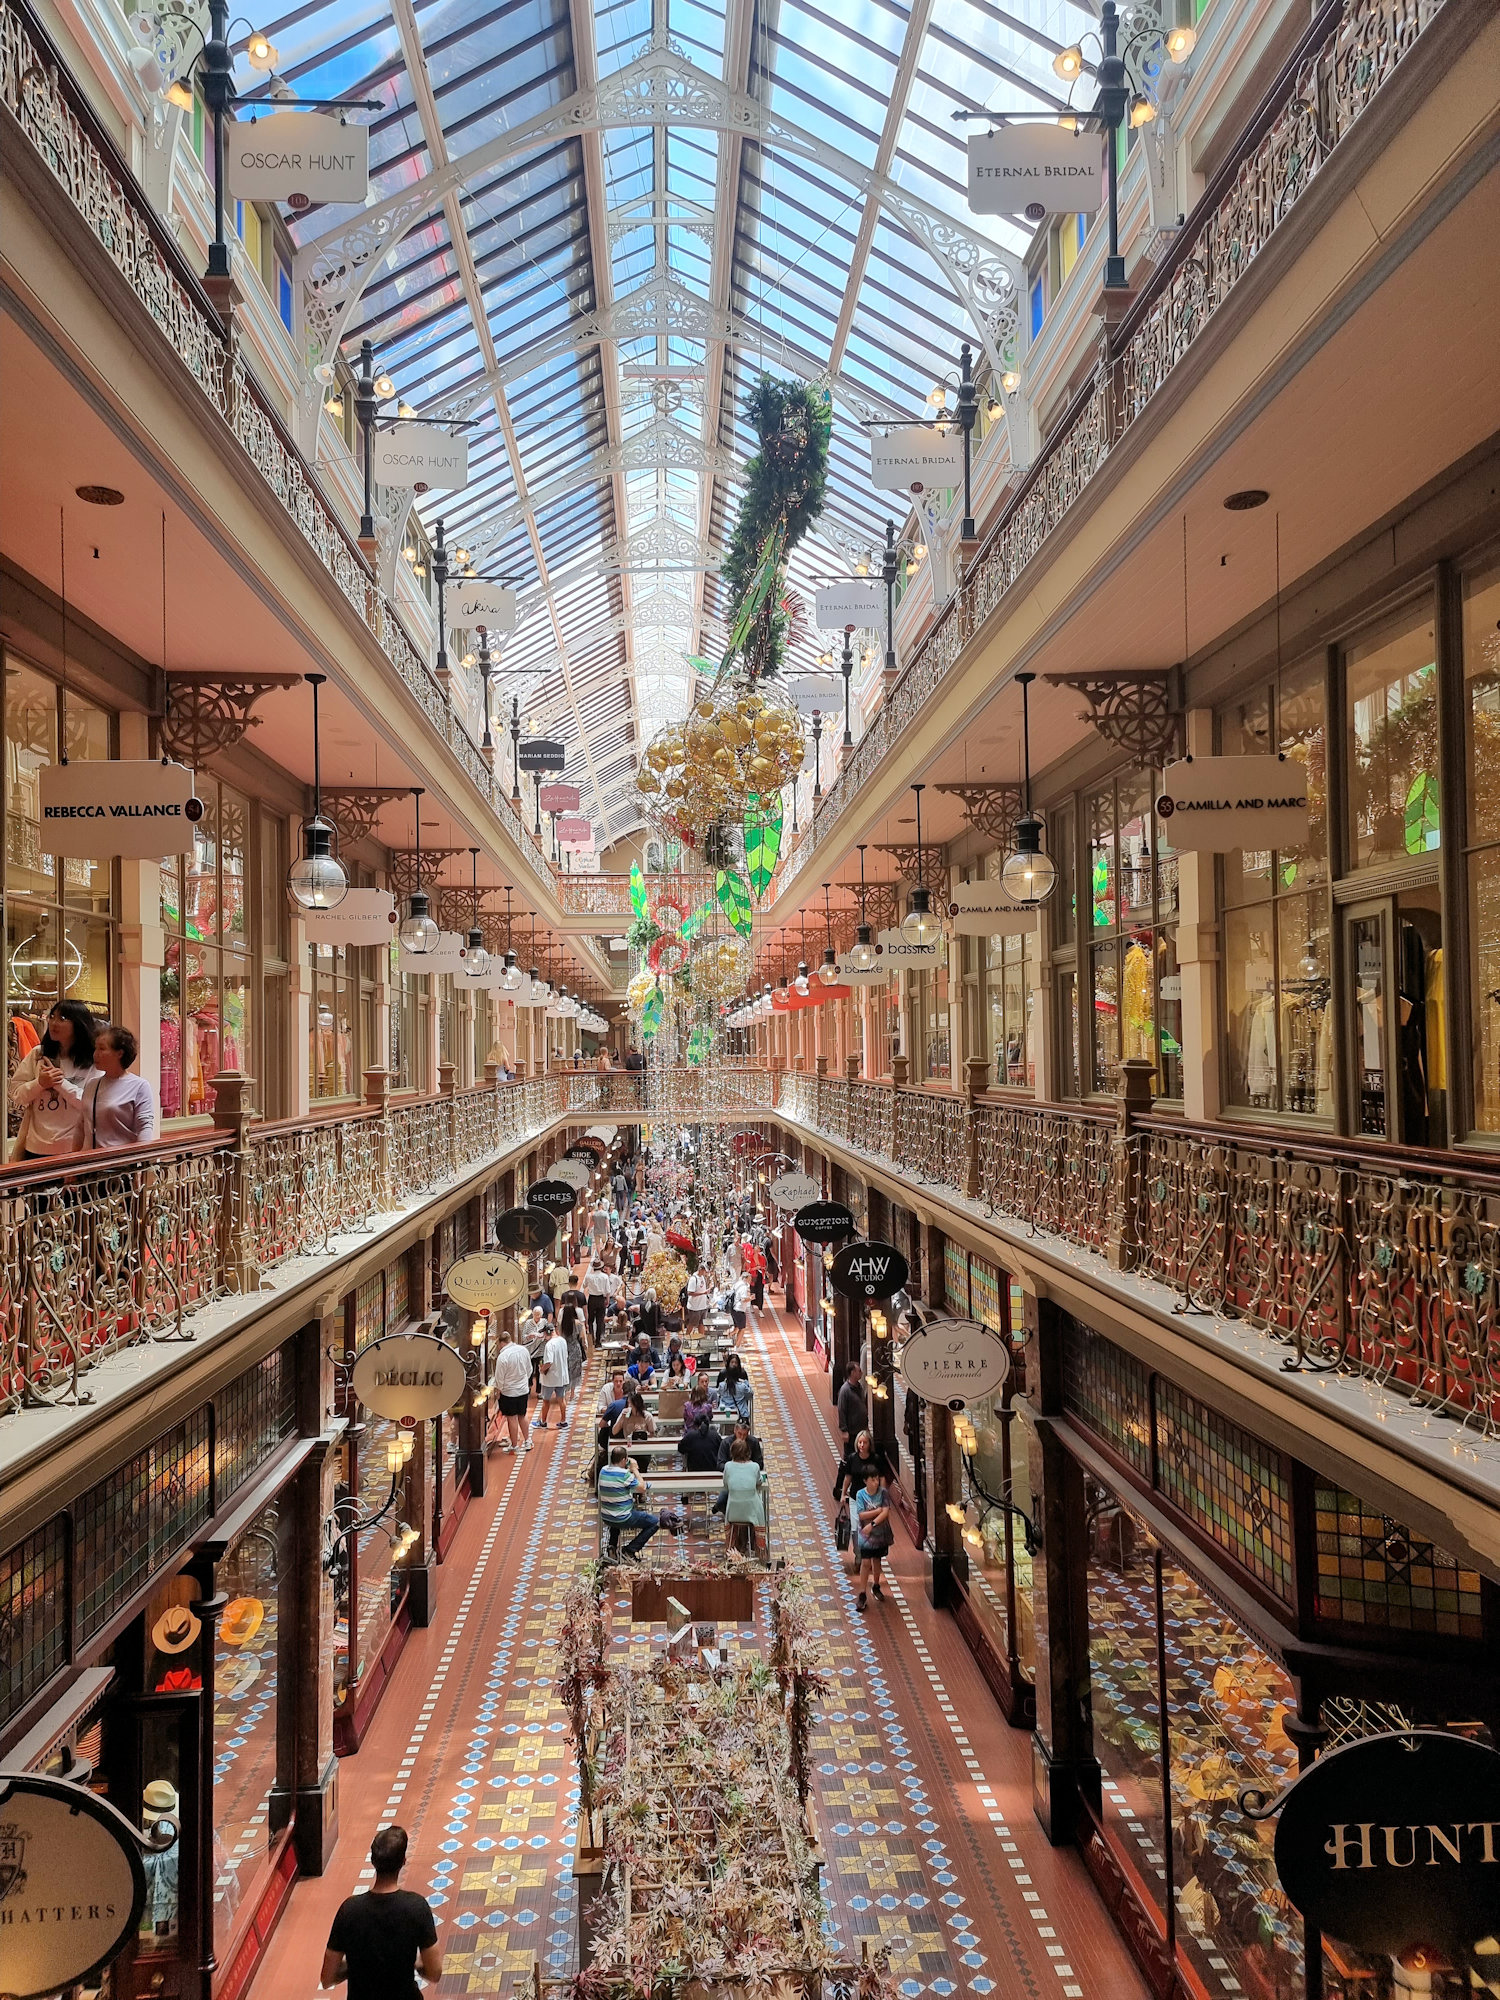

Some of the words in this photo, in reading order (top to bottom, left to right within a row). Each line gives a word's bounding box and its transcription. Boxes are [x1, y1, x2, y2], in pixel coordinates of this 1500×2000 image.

[240, 152, 302, 169] OSCAR
[309, 154, 356, 170] HUNT
[976, 166, 1041, 178] ETERNAL
[1044, 165, 1095, 176] BRIDAL
[382, 453, 424, 466] OSCAR
[428, 456, 460, 468] HUNT
[876, 457, 920, 466] ETERNAL
[922, 456, 956, 464] BRIDAL
[461, 597, 501, 617] akira
[1160, 801, 1172, 812] 55
[1175, 799, 1232, 811] CAMILLA
[1235, 799, 1264, 809] AND
[1267, 797, 1307, 808] MARC
[44, 806, 106, 818] REBECCA
[108, 804, 181, 817] VALLANCE
[960, 906, 993, 914] CAMILLA
[994, 905, 1012, 913] AND
[532, 1192, 574, 1204] SECRETS
[797, 1217, 850, 1227] GUMPTION
[847, 1256, 891, 1276] AHW
[454, 1276, 517, 1288] QUALITEA
[855, 1273, 884, 1282] STUDIO
[923, 1359, 988, 1370] PIERRE
[403, 1417, 413, 1425] 10
[1323, 1822, 1500, 1870] HUNT
[1, 1903, 116, 1925] HATTERS
